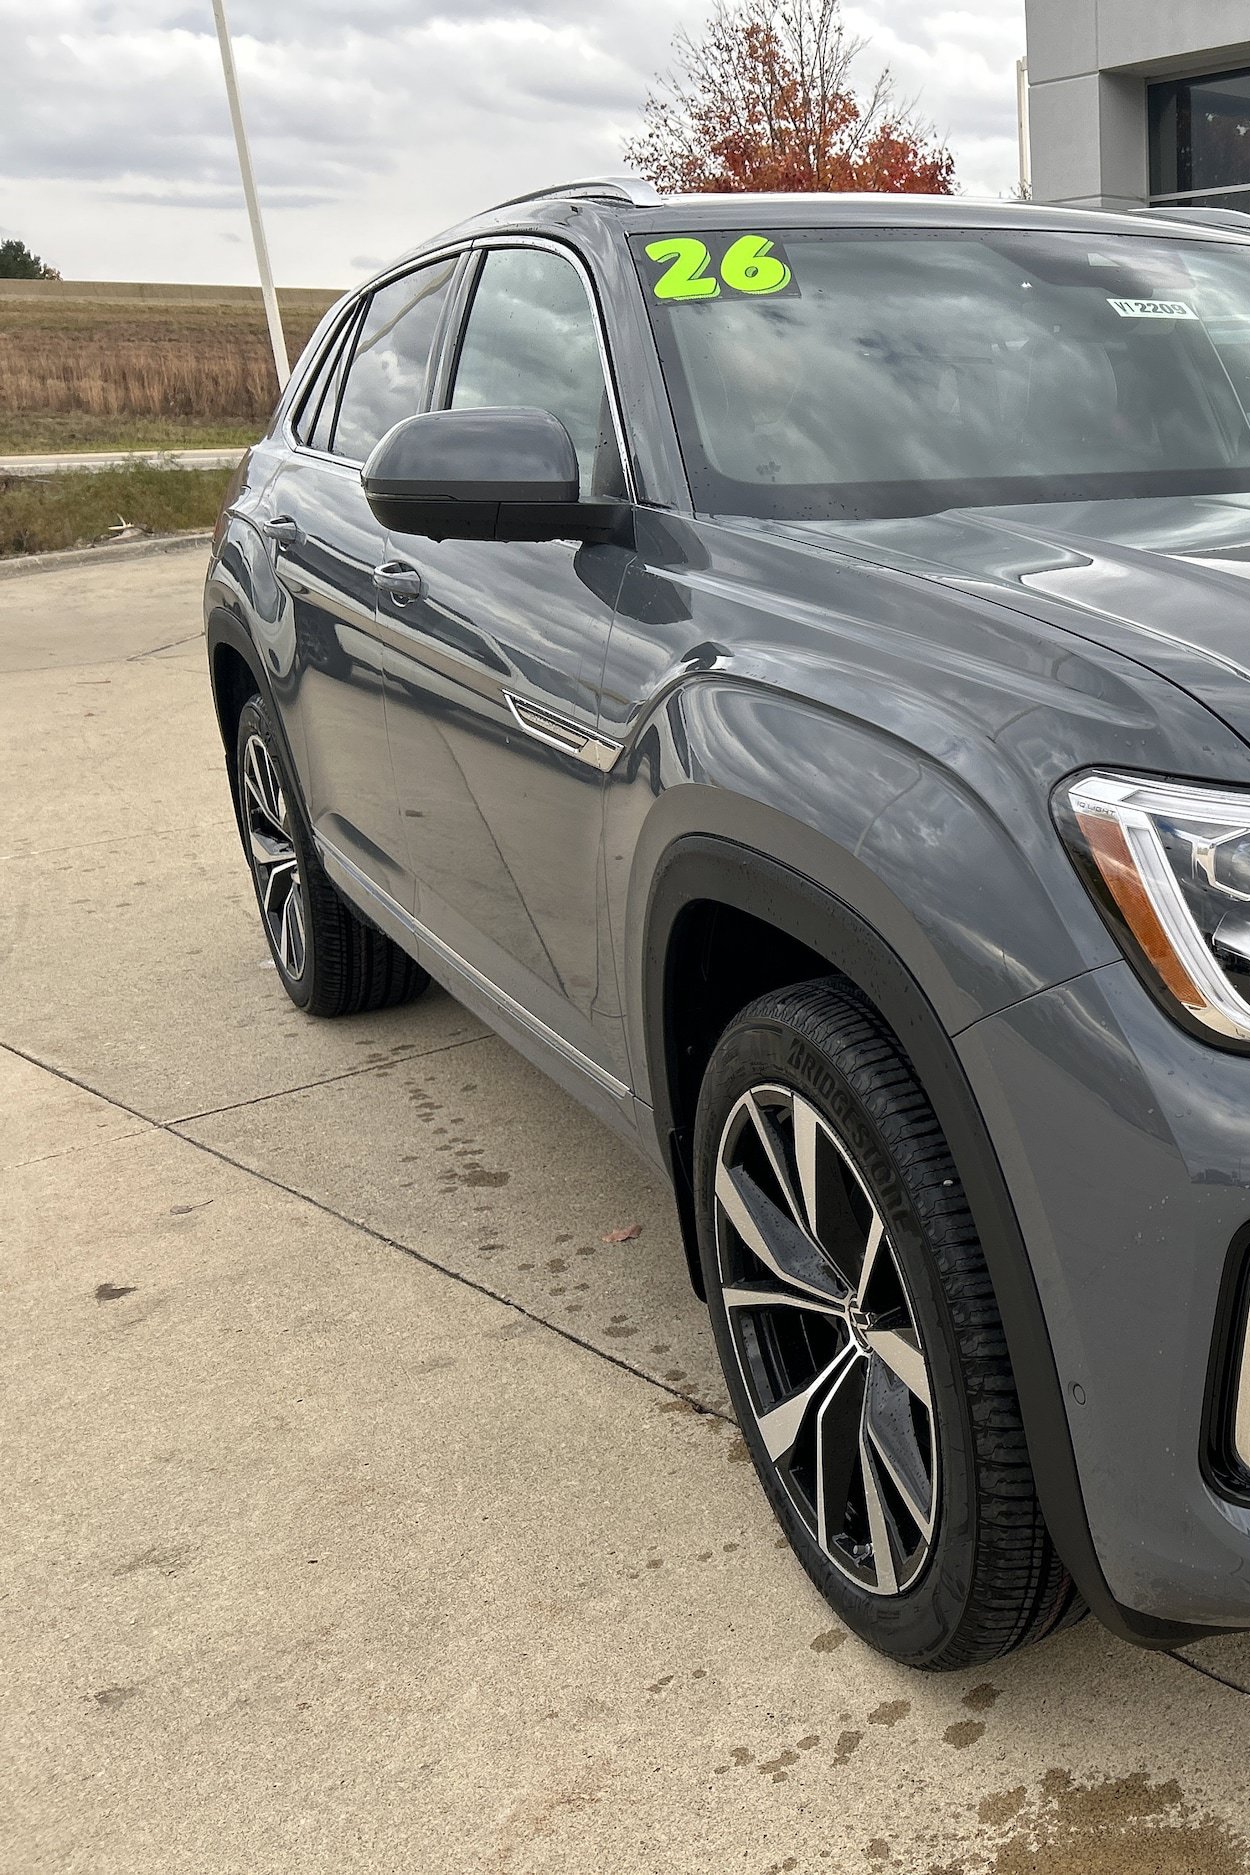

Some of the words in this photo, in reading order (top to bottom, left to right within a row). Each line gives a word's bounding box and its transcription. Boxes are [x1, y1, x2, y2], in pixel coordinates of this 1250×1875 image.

[644, 234, 791, 300] 26
[1113, 301, 1187, 315] V12209
[787, 1037, 914, 1234] BRIDGESTONE
